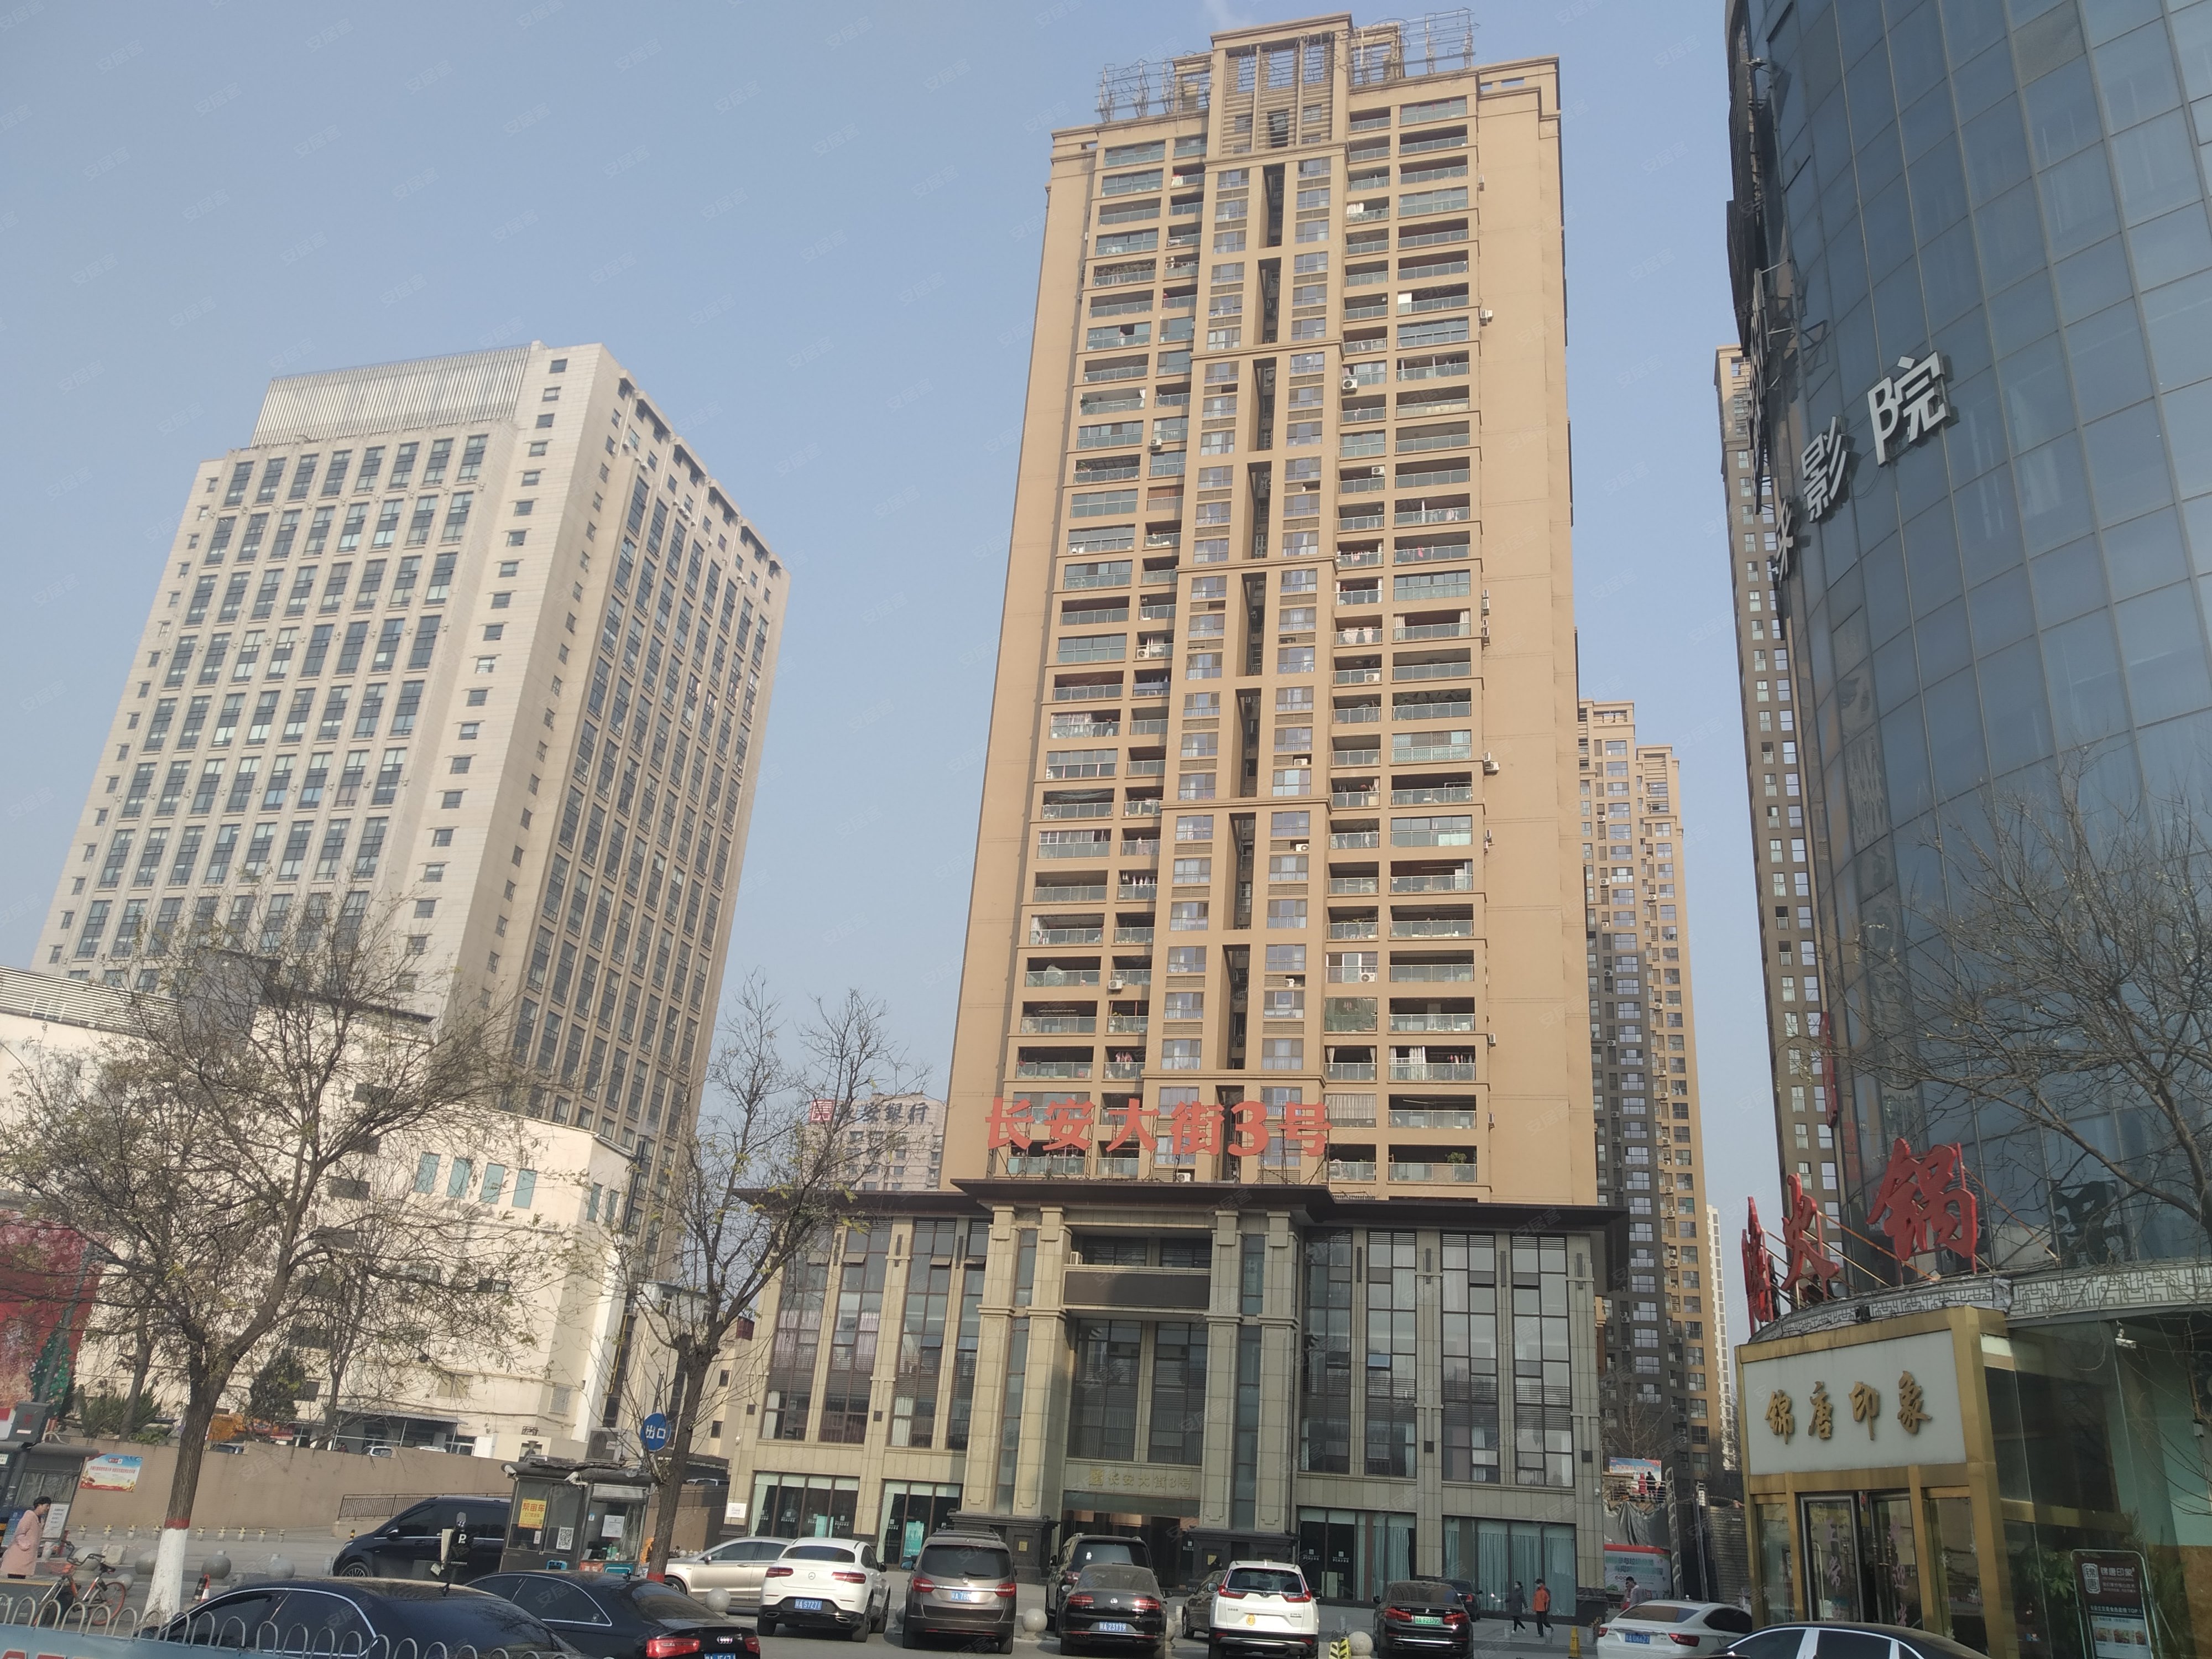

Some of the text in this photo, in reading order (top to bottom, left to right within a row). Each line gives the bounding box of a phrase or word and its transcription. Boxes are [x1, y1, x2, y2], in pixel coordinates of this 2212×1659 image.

[985, 1097, 1333, 1157] 长安大街3号
[1766, 1370, 1932, 1444] 锦唐印象
[645, 1424, 666, 1439] 出口
[1109, 1472, 1192, 1490] 长安大街3号
